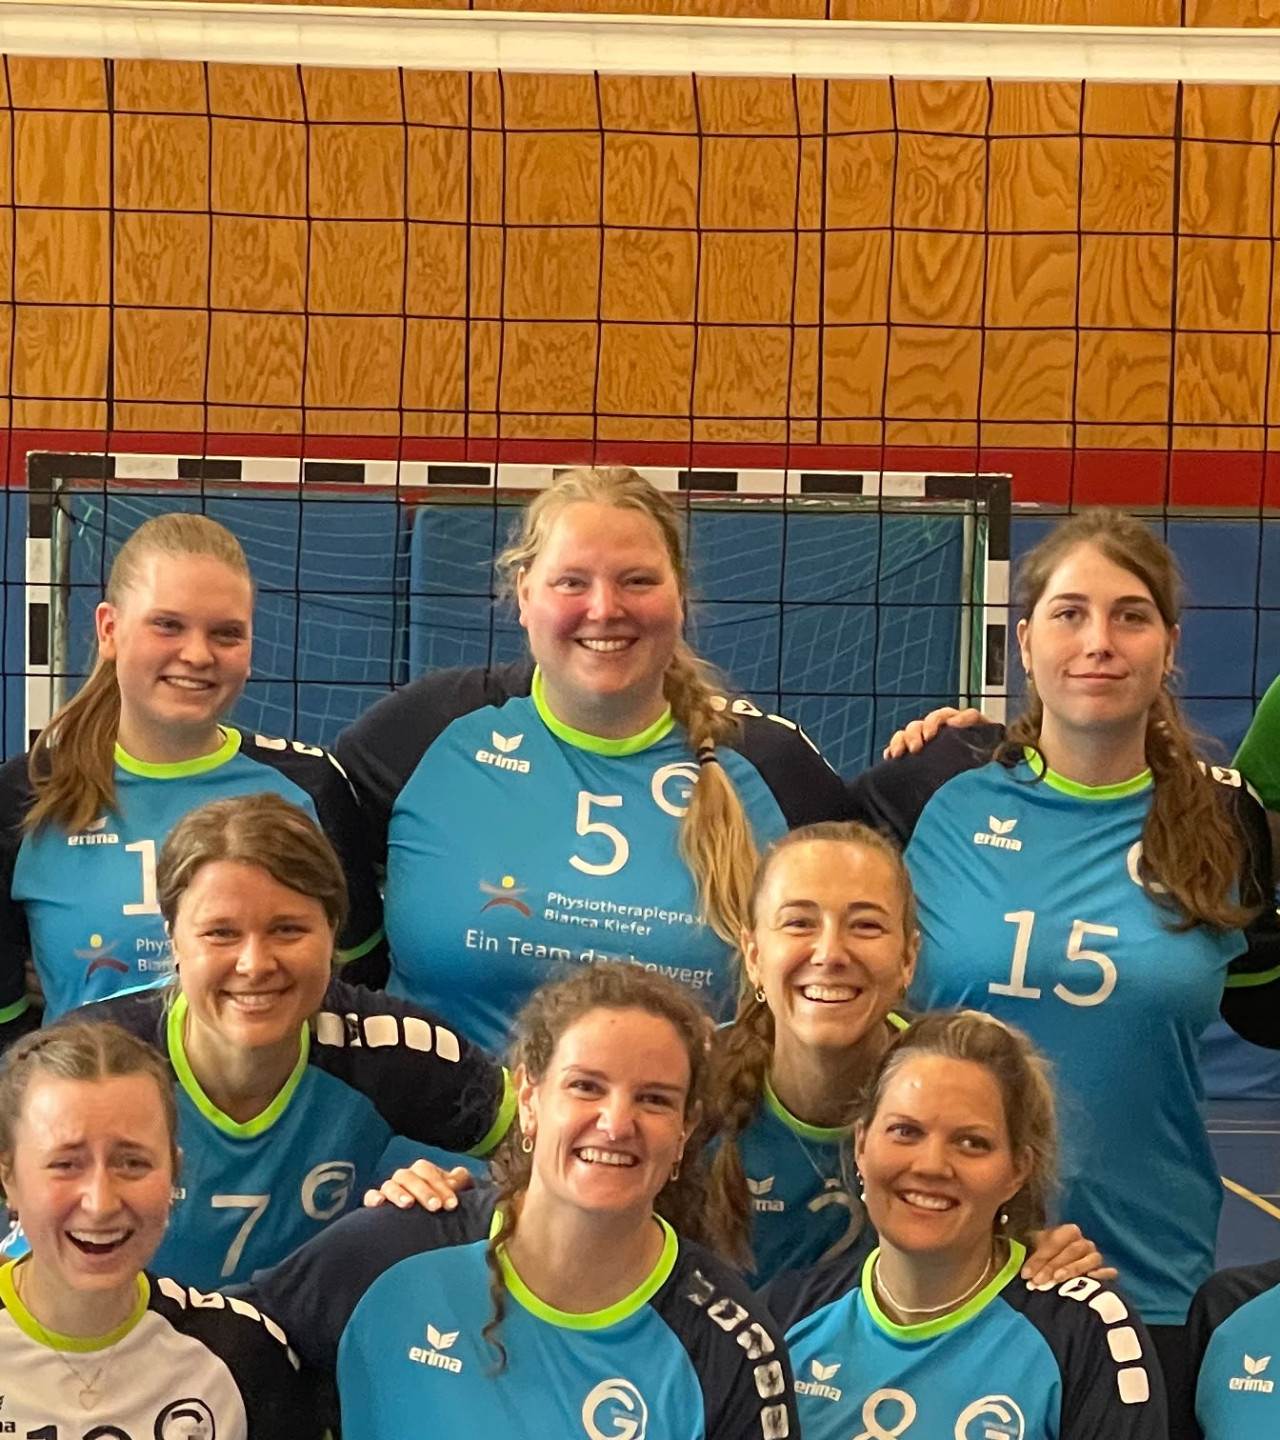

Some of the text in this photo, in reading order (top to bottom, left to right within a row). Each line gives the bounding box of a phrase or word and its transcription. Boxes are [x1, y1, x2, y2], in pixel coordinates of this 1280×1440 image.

[475, 749, 531, 774] erima
[68, 833, 119, 846] erima
[569, 790, 630, 876] 5
[973, 832, 1022, 852] erima
[544, 909, 652, 937] Bianca Kiefer
[466, 929, 499, 953] Ein
[508, 936, 571, 962] Team
[988, 909, 1119, 1007] 15
[211, 1194, 271, 1278] 7
[408, 1345, 462, 1373] erima
[794, 1379, 842, 1402] erima
[1228, 1375, 1275, 1393] erima
